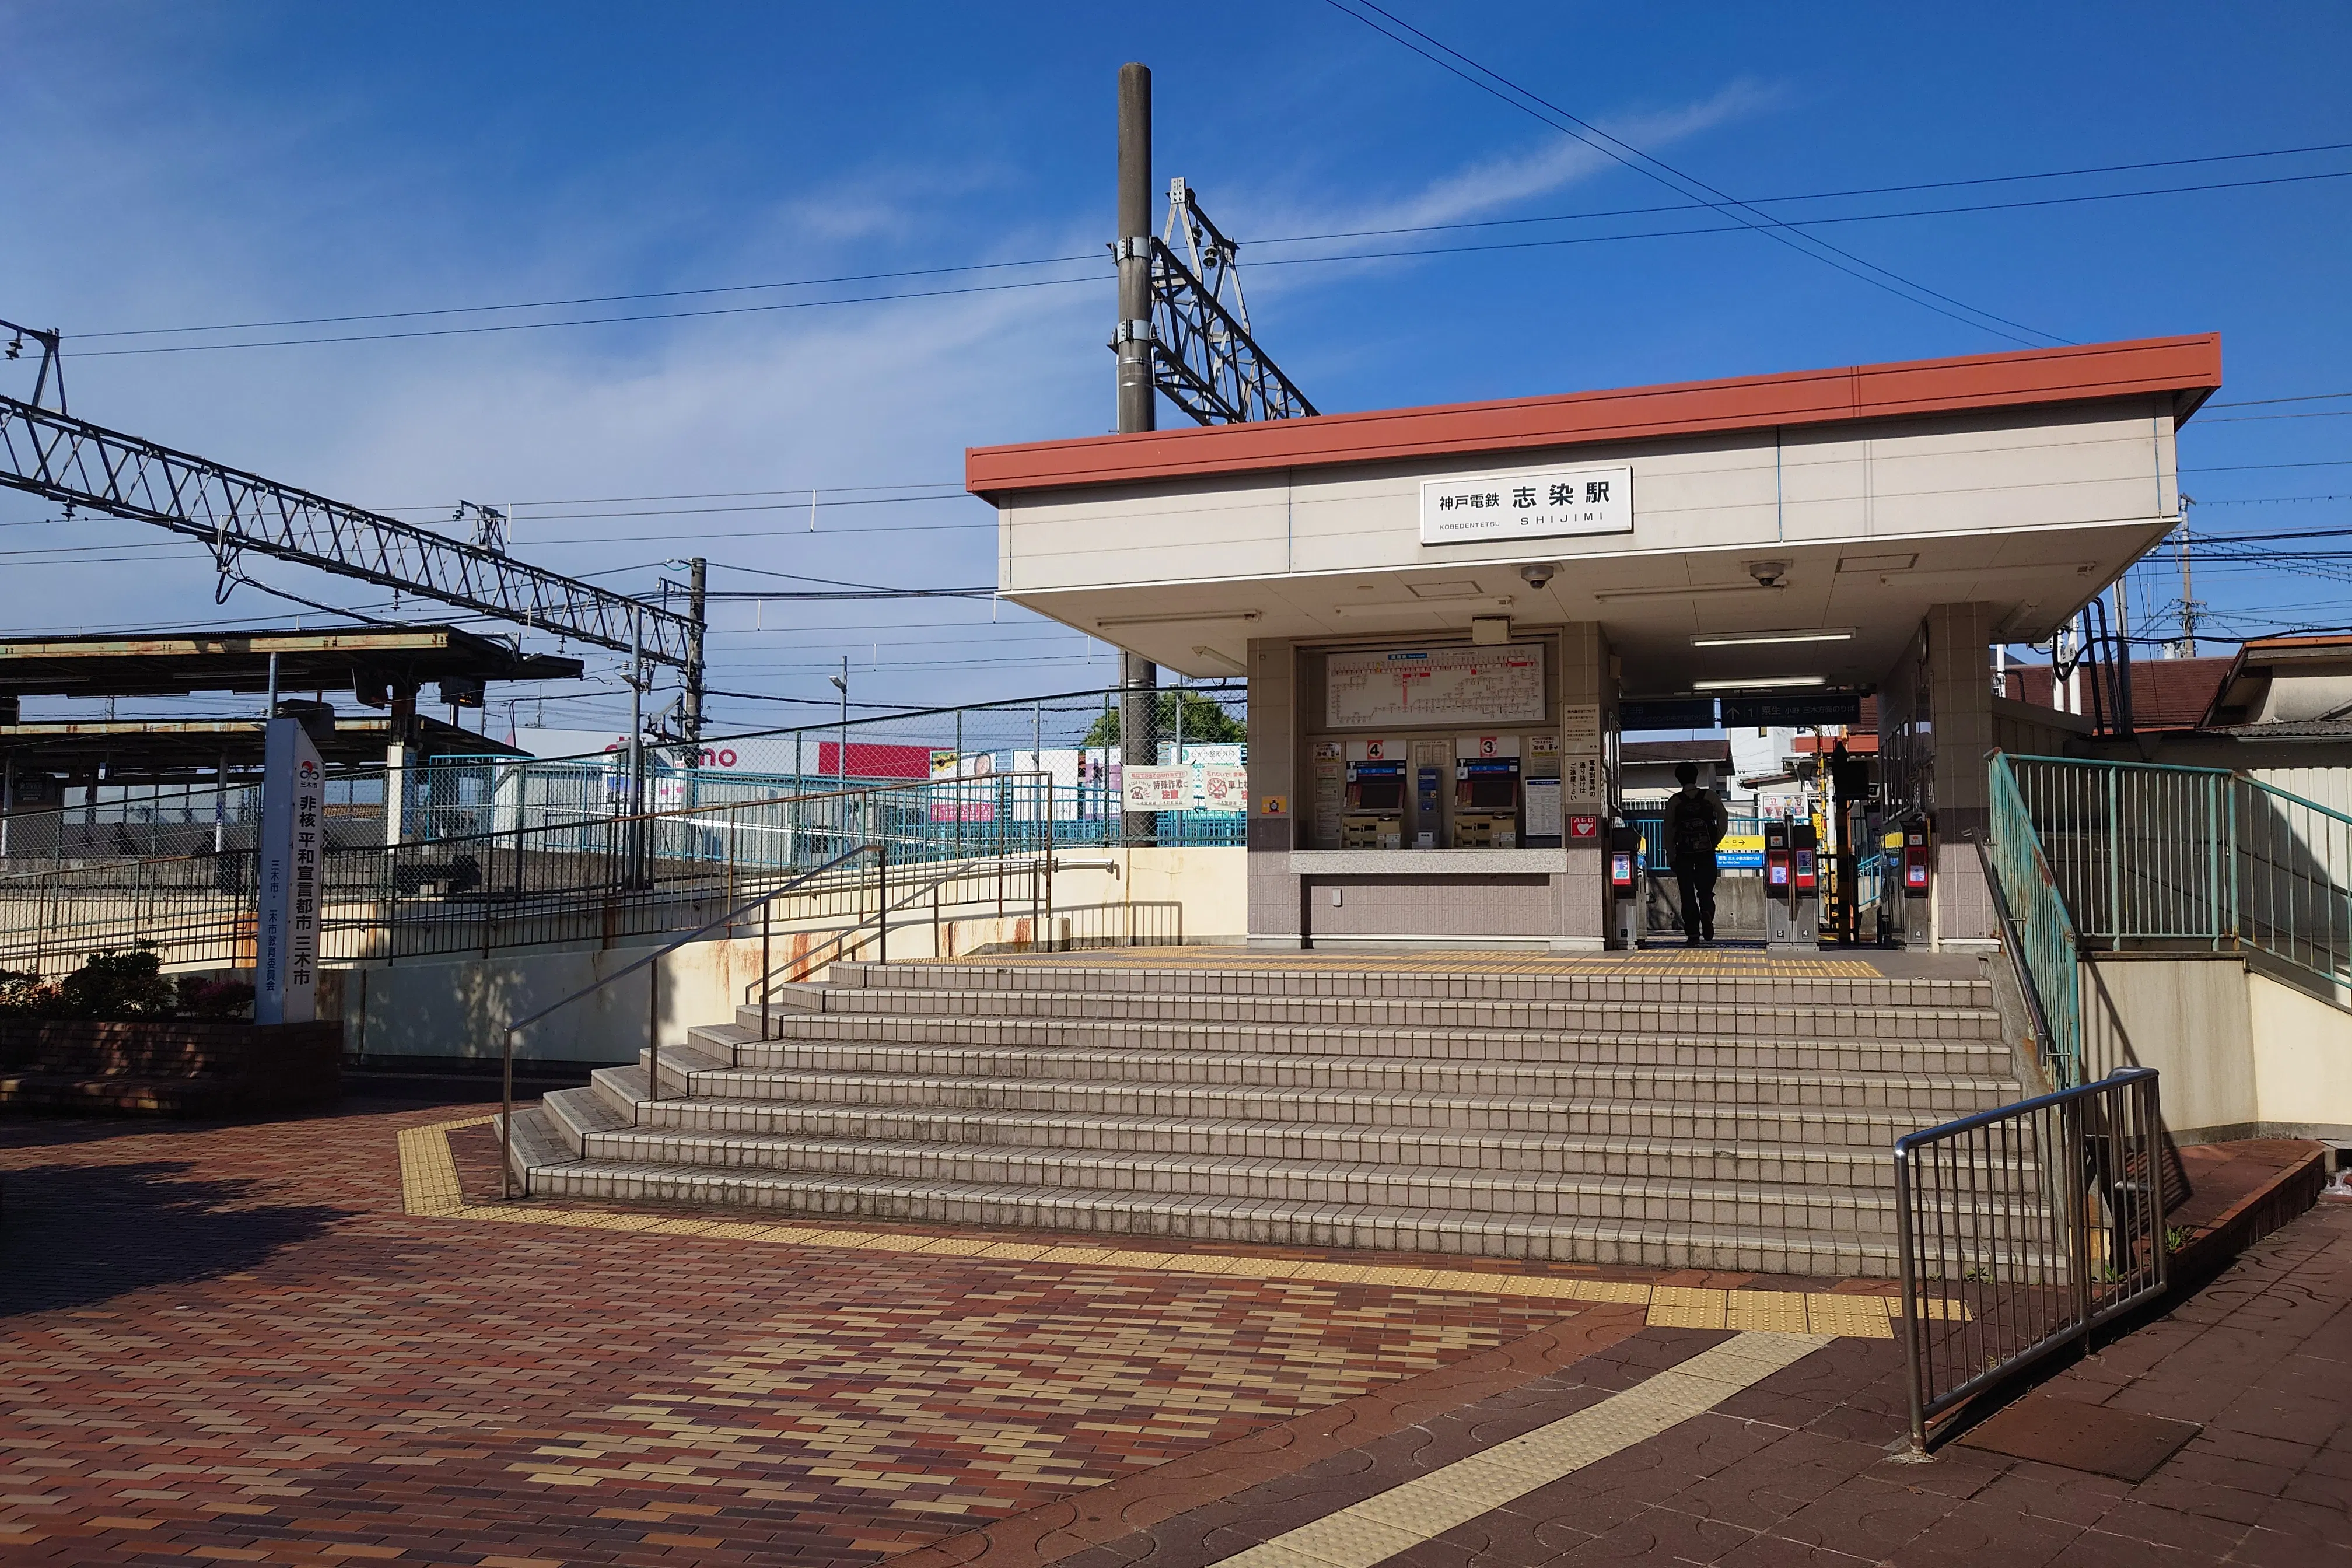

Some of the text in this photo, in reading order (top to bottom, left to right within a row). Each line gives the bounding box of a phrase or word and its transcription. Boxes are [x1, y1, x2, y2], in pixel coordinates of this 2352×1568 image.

[1439, 481, 1611, 511] 神戸電鉄 志染駅
[1440, 512, 1603, 530] KOBEDENTETSU SHIJIMI
[1762, 705, 1781, 715] 粟生
[1803, 705, 1856, 715] 三木方面のりば
[1370, 744, 1379, 756] 4
[1483, 741, 1493, 753] 3
[1153, 779, 1189, 790] 特殊詐欺に
[1162, 789, 1179, 800] 注意
